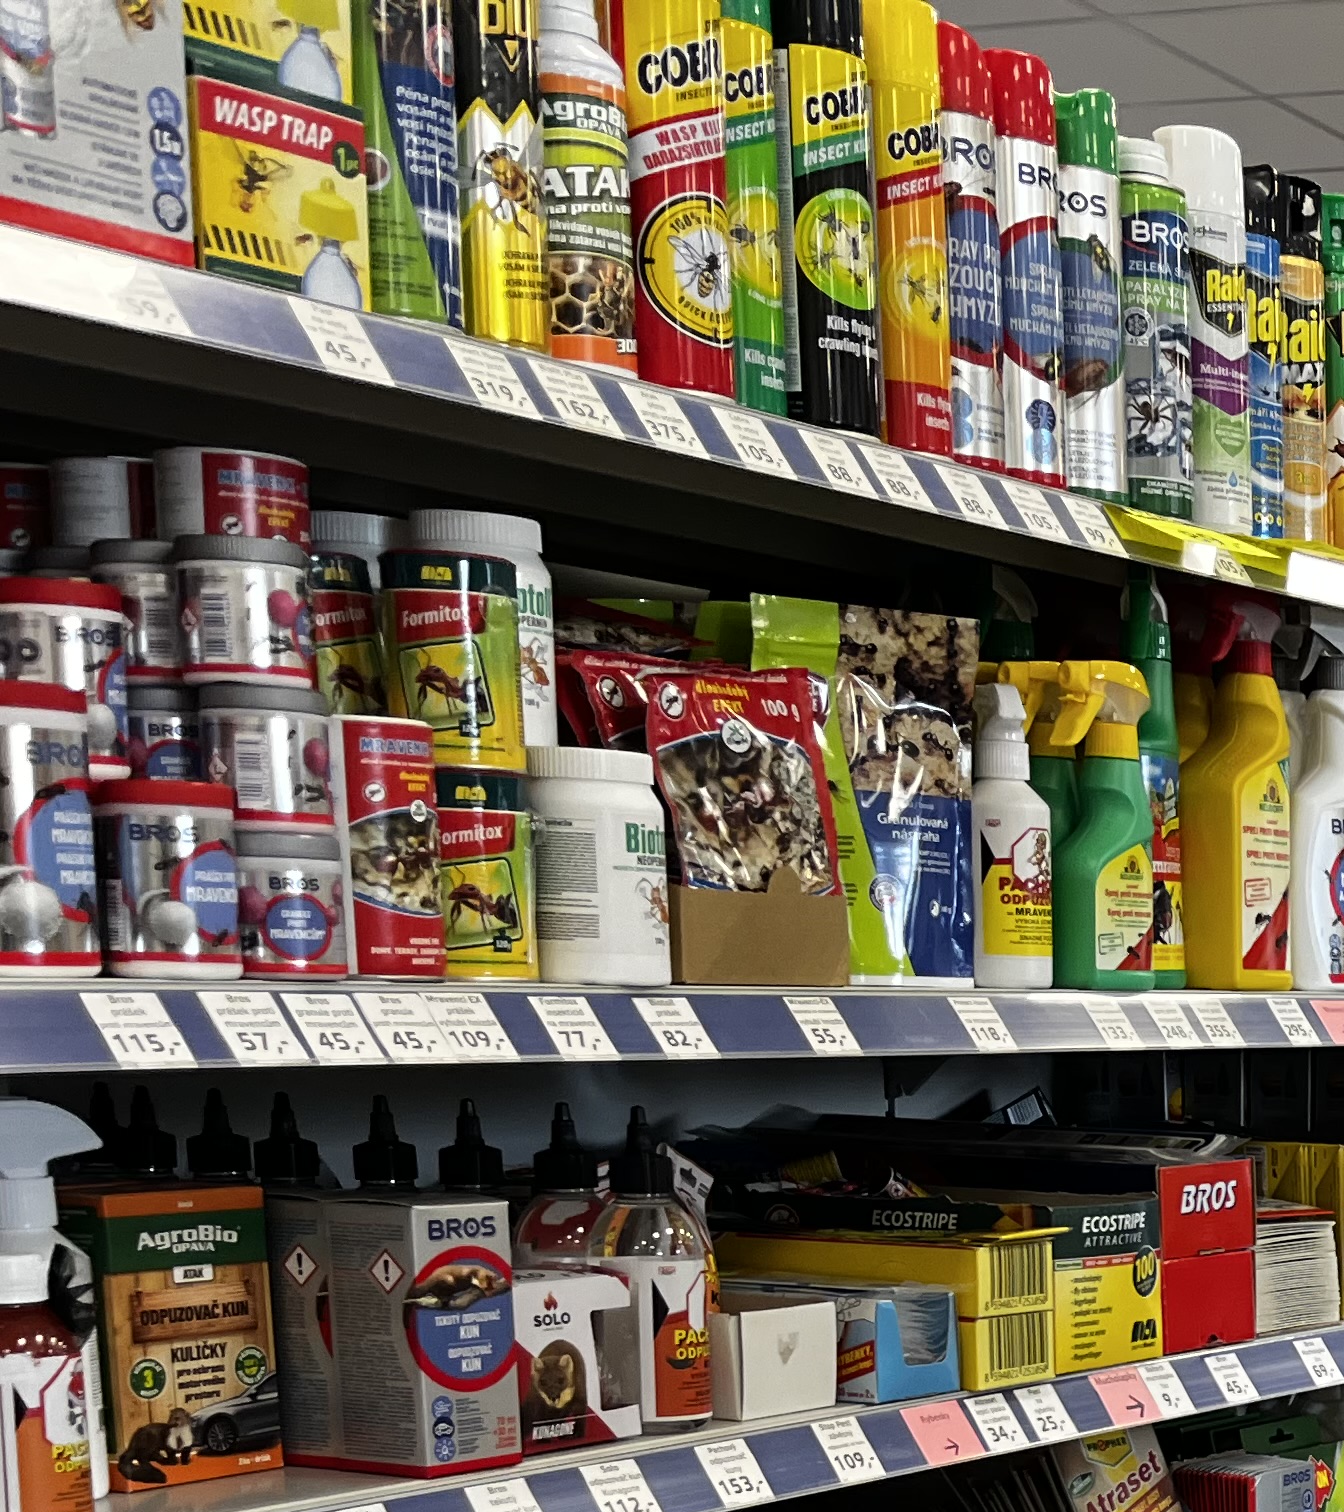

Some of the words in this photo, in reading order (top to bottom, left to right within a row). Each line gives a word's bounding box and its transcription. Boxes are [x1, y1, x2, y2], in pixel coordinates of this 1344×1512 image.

[214, 96, 278, 138] WASP
[281, 116, 332, 151] TRAP
[1181, 1180, 1237, 1213] BROS
[427, 1216, 497, 1242] BROS
[872, 1210, 958, 1230] ECOSTRIPE
[1081, 1211, 1146, 1233] ECOSTRIPE
[137, 1224, 237, 1253] AgroBio
[139, 1304, 216, 1327] ODPUZOVAČ
[221, 1301, 249, 1320] KUN
[533, 1312, 570, 1328] SOLO
[171, 1340, 226, 1362] KULIČKY
